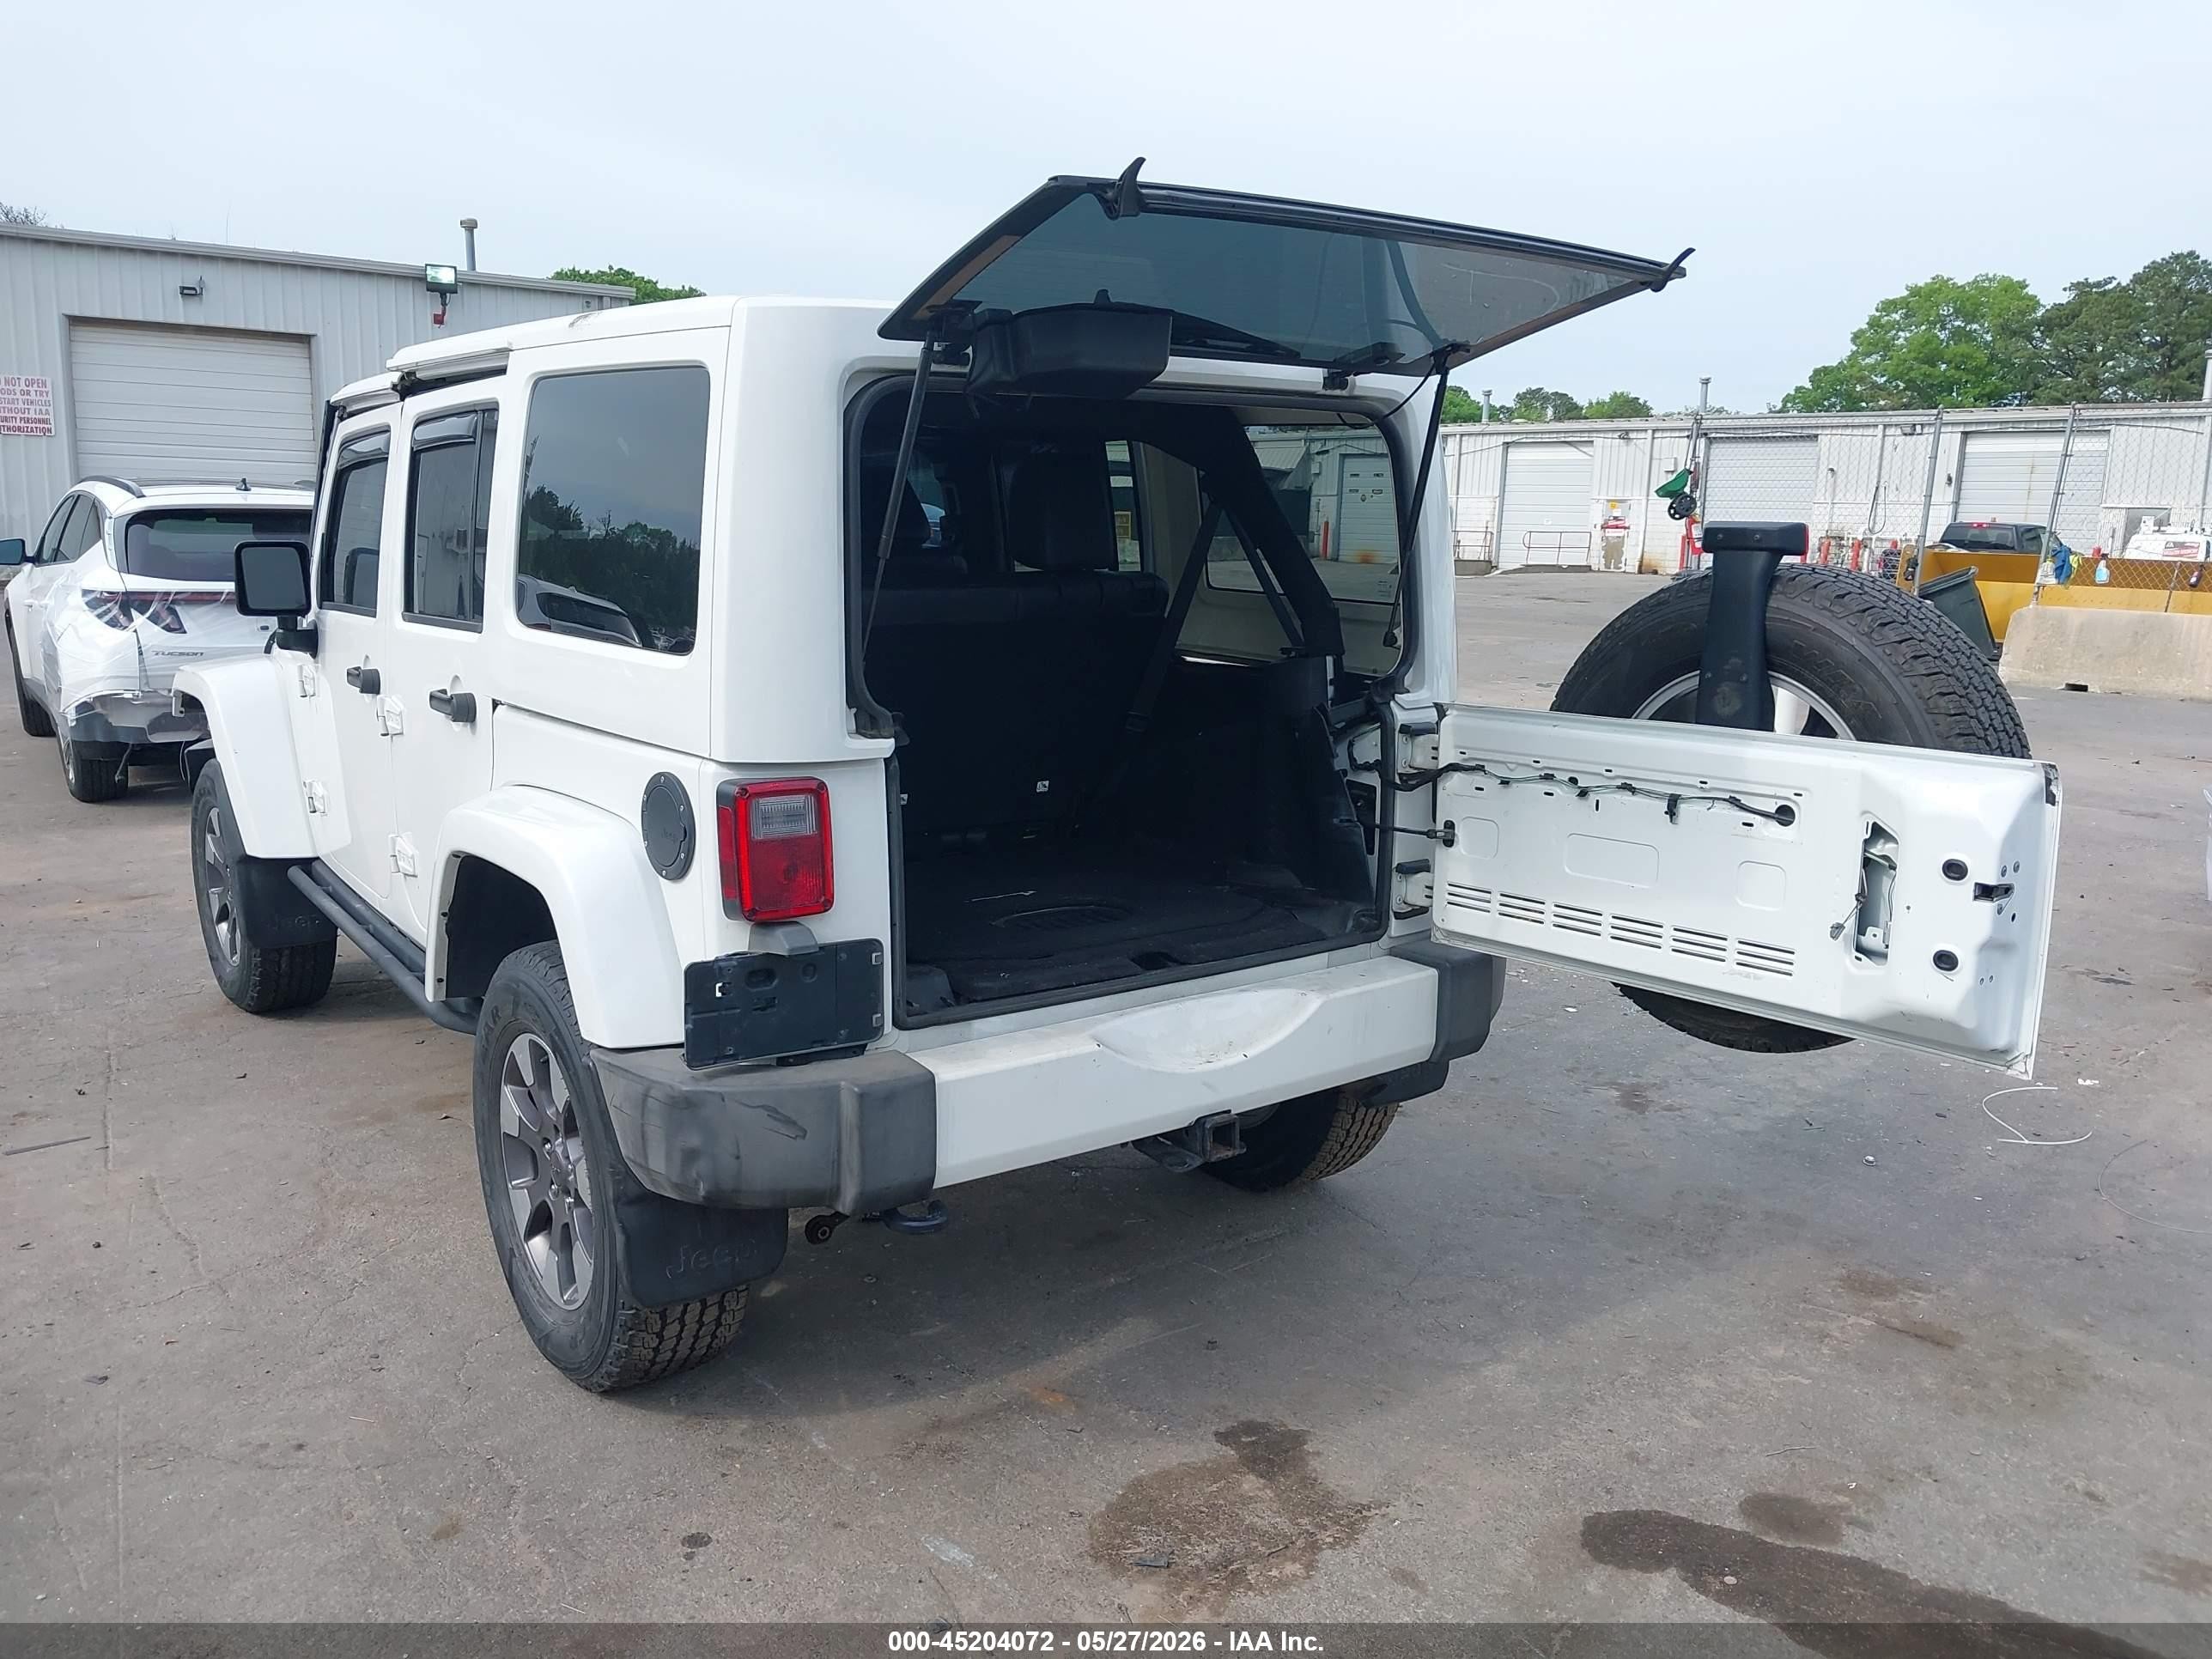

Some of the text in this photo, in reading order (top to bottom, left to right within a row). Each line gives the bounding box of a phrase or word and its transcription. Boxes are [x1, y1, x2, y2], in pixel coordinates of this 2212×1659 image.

[4, 377, 47, 388] NOT OPEN
[20, 389, 32, 398] OR
[34, 390, 50, 398] TRY
[21, 398, 52, 407] VEHICLES
[19, 416, 52, 425] PERSONNEL
